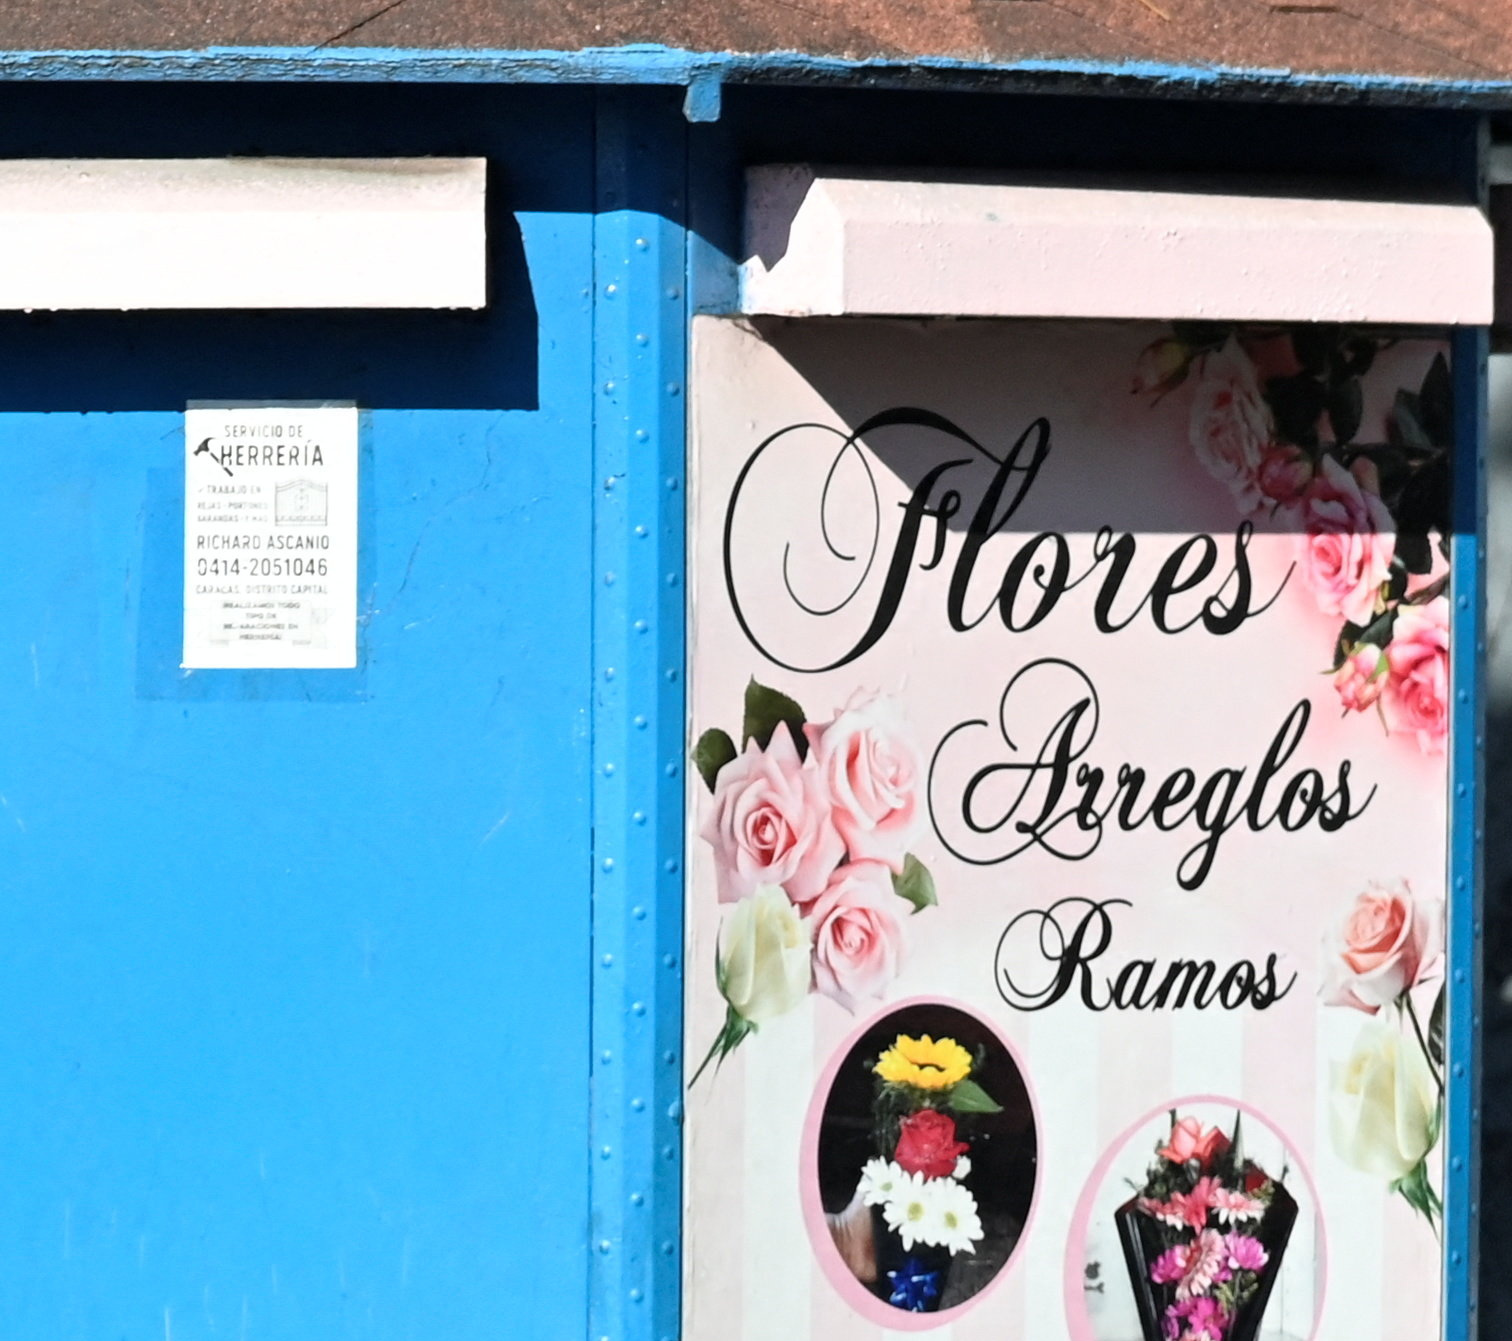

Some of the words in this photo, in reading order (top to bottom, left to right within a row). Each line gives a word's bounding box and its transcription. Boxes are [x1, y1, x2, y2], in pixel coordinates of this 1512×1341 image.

[224, 424, 283, 438] SERVICIO
[288, 424, 303, 438] DE
[220, 439, 324, 467] HERRERÍA
[196, 534, 261, 550] RICHARD
[266, 534, 330, 550] ASCANIO
[723, 406, 1298, 673] Flores
[197, 557, 328, 577] 0414-2051046
[928, 657, 1377, 891] Arreglos
[994, 897, 1298, 1012] Ramos
